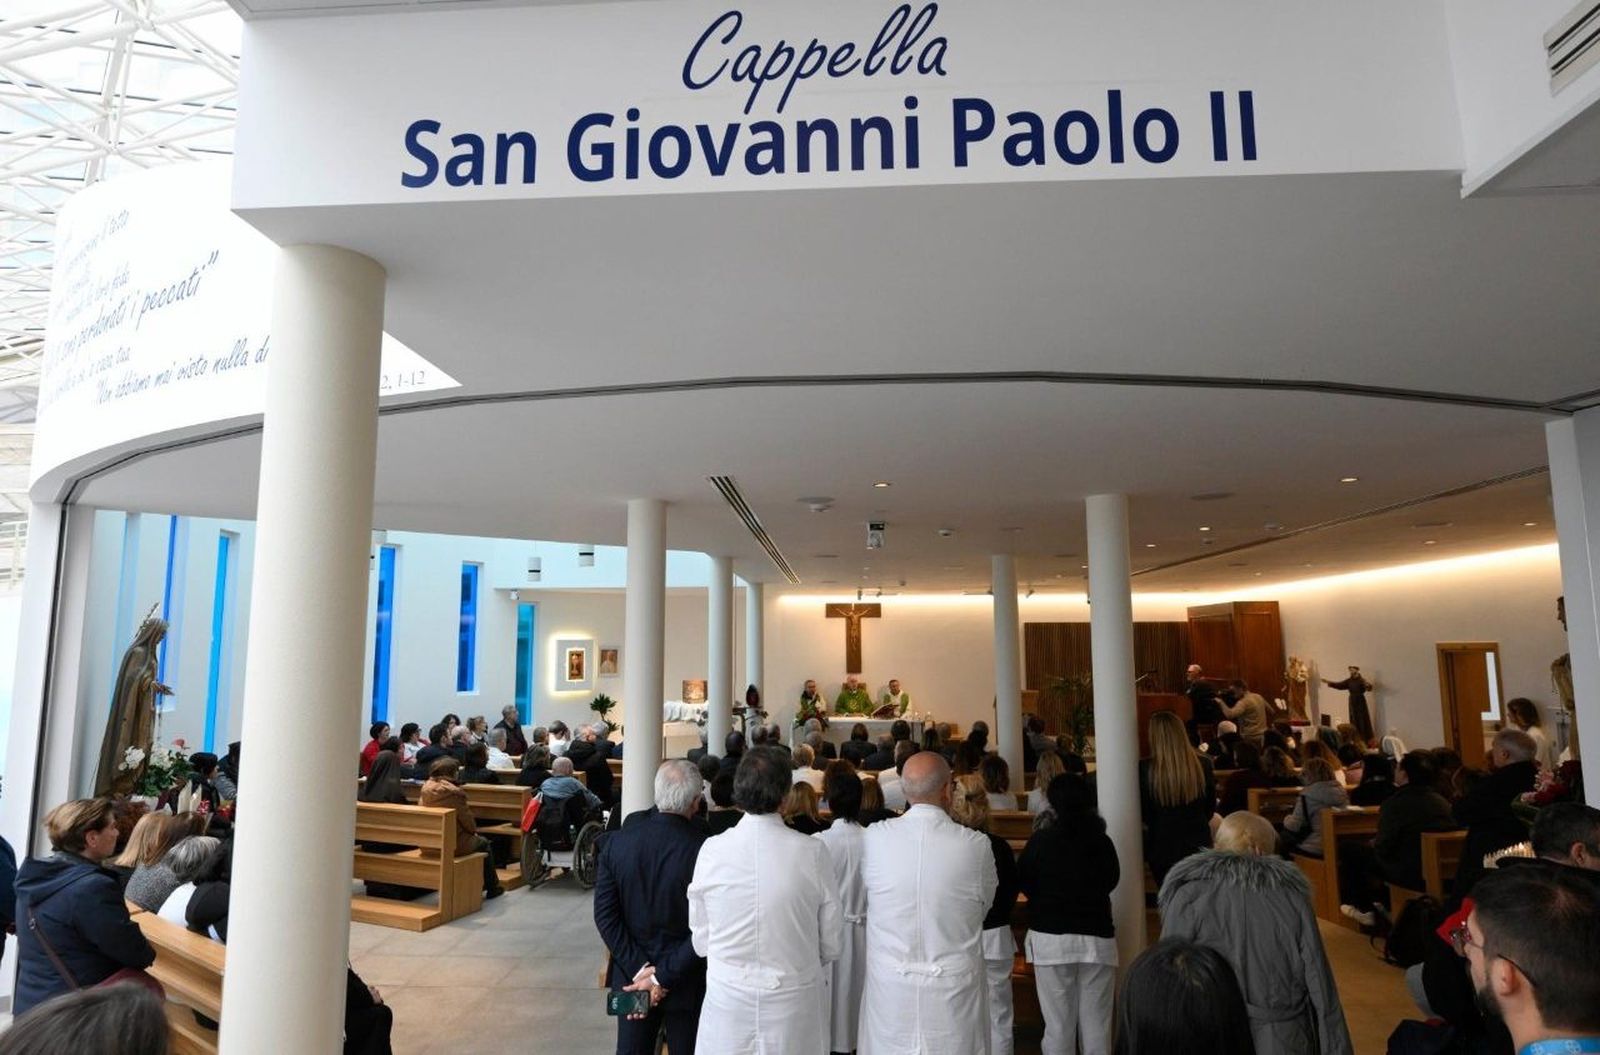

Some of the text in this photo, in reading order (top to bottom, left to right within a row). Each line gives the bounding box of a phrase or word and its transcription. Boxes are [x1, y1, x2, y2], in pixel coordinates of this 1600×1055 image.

[682, 2, 948, 115] Cappella
[401, 89, 1258, 189] San Giovanni Paolo II
[153, 360, 176, 389] mai
[177, 355, 209, 381] visto
[212, 337, 250, 375] nulla
[254, 334, 271, 364] di
